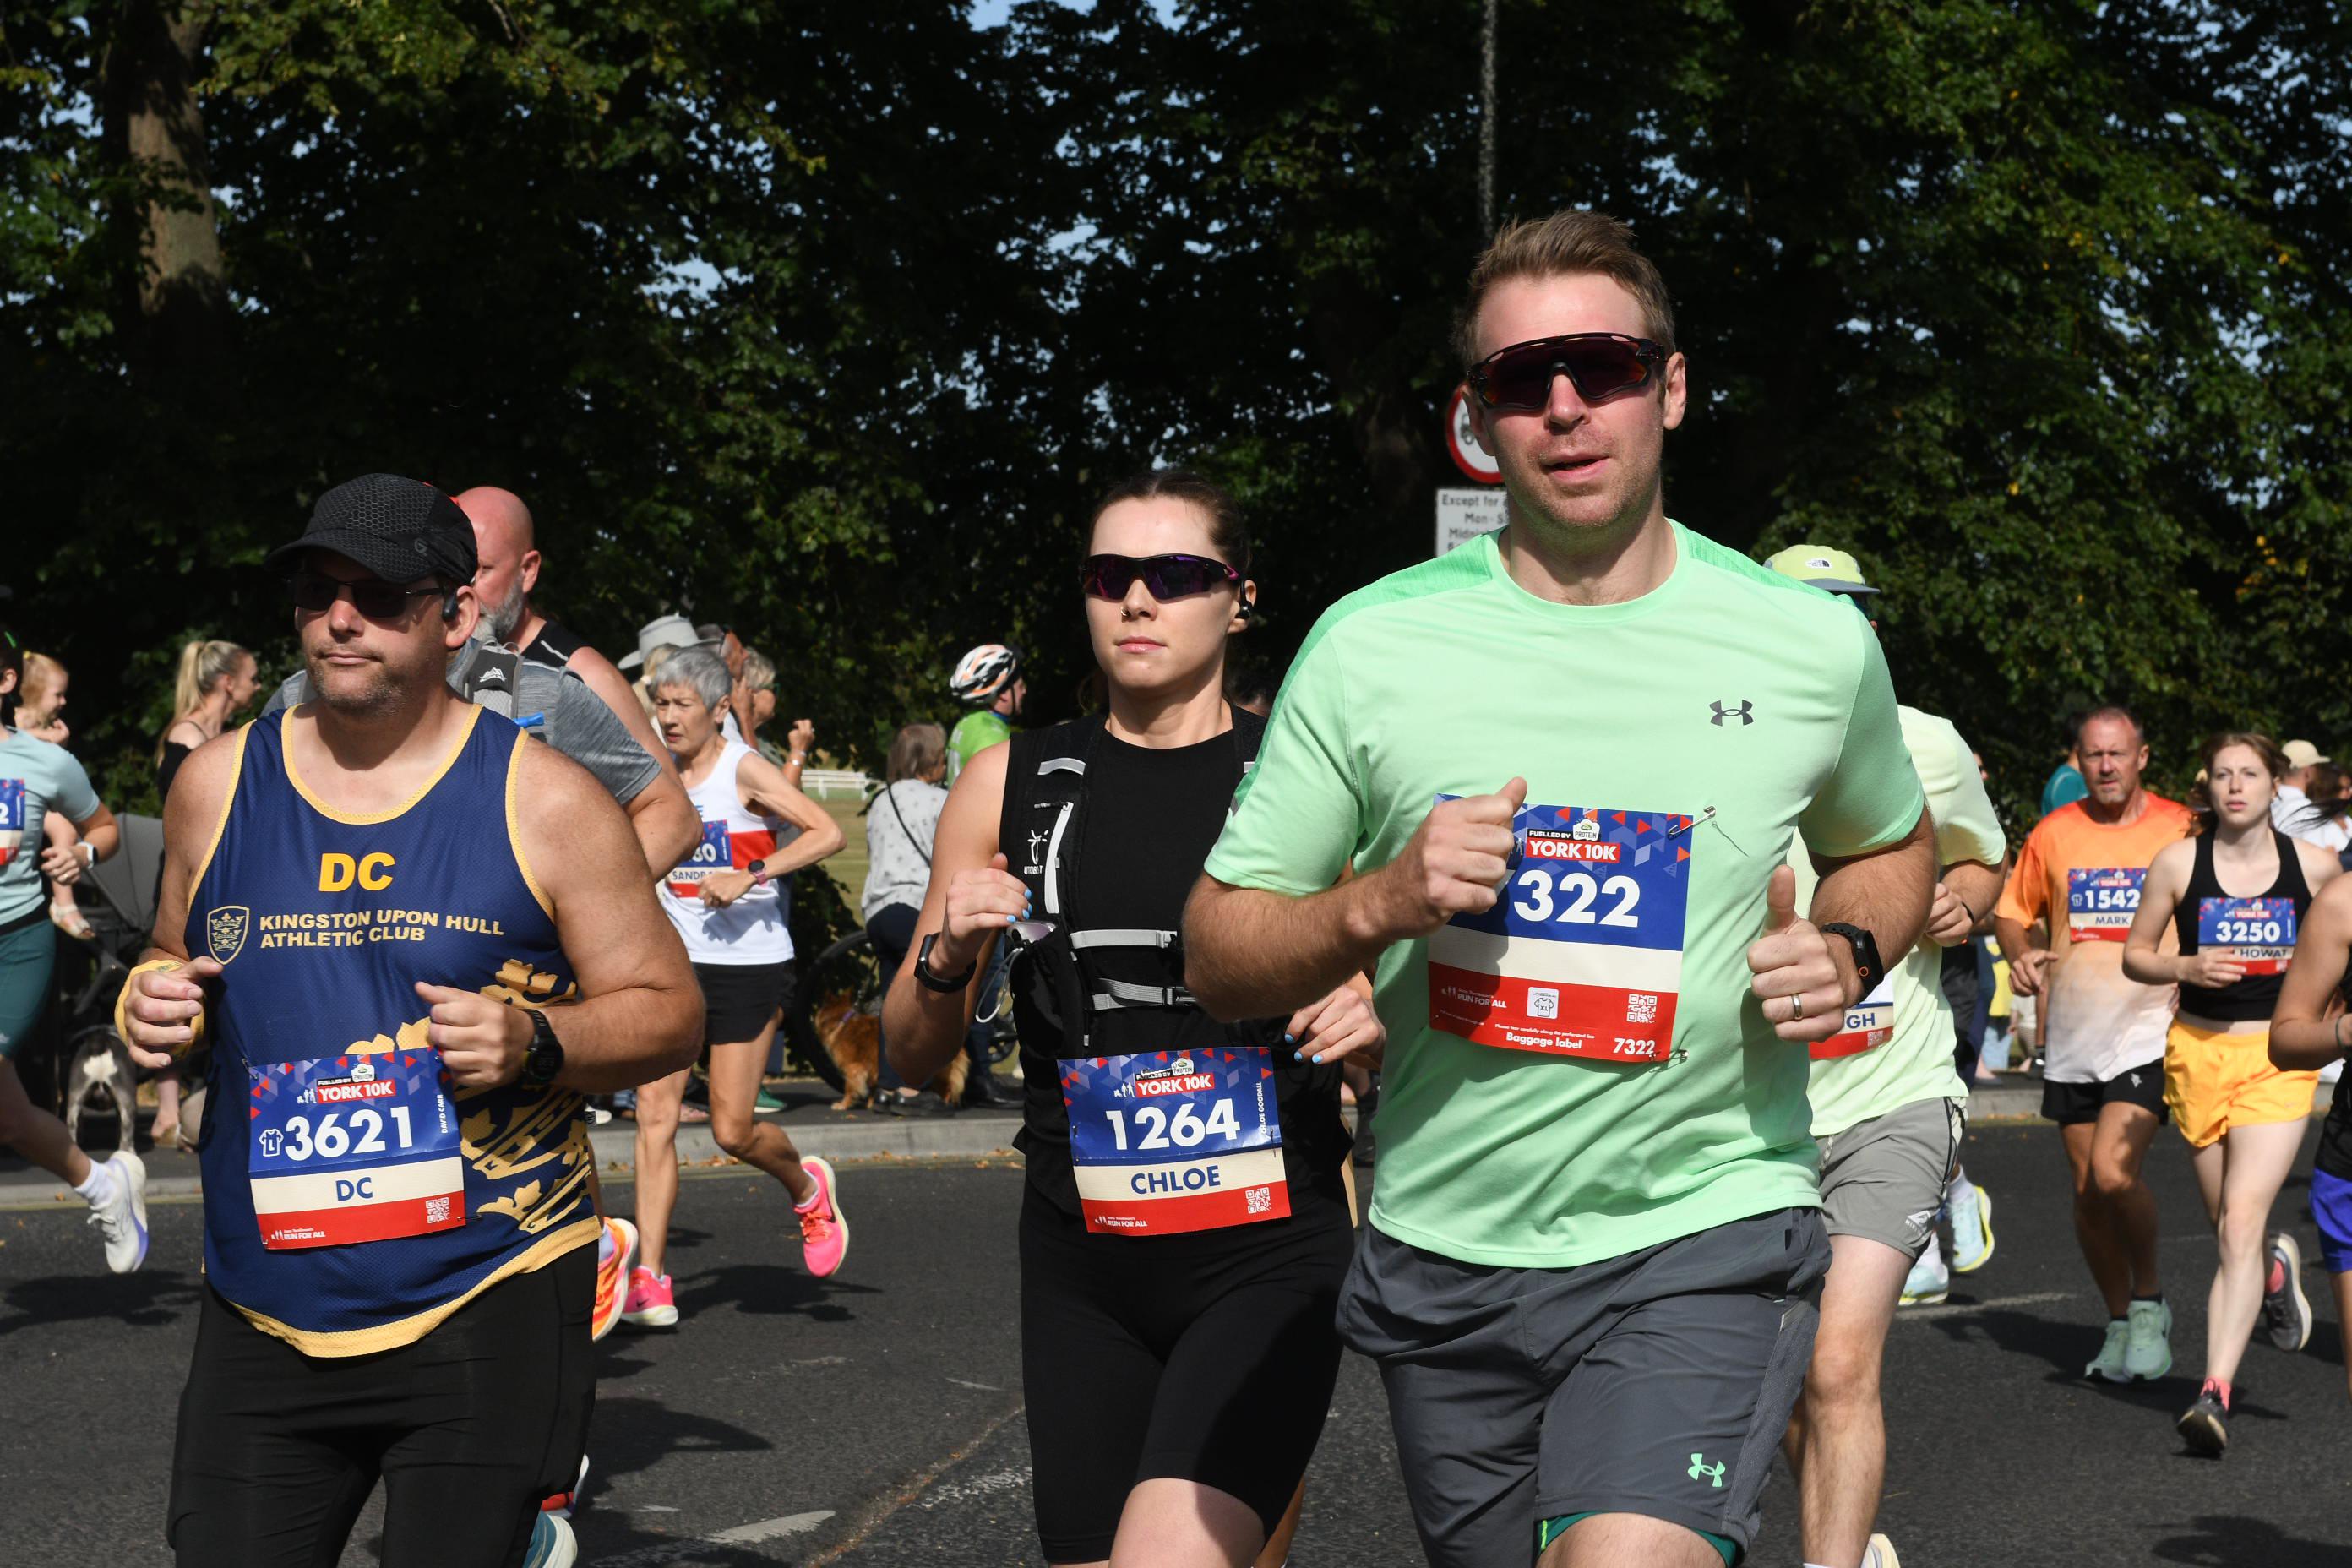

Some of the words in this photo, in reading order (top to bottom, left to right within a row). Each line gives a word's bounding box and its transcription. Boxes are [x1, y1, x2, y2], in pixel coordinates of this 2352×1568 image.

[1442, 494, 1478, 506] Except
[1484, 495, 1498, 506] for
[1465, 513, 1488, 523] Mon
[1529, 840, 1581, 858] YORK
[1585, 844, 1617, 860] 10K
[318, 852, 395, 892] DC
[672, 871, 712, 880] SANDR
[1514, 869, 1640, 928] 322
[2085, 889, 2141, 908] 1542
[259, 911, 371, 931] KINGSTON
[377, 909, 438, 927] UPON
[445, 915, 505, 936] HULL
[2216, 921, 2280, 942] 3250
[260, 929, 364, 948] ATHLETIC
[368, 927, 425, 942] CLUB
[2240, 949, 2287, 957] HOWAT
[1457, 994, 1473, 1002] RUN
[1846, 1012, 1876, 1029] GH
[1506, 1032, 1553, 1047] Baggage
[1555, 1037, 1582, 1048] label
[1613, 1038, 1655, 1055] 7322
[318, 1085, 363, 1102] YORK
[364, 1081, 394, 1097] 10K
[1138, 1078, 1183, 1096] YORK
[1184, 1075, 1212, 1091] 10K
[285, 1106, 412, 1161] 3621
[1106, 1098, 1240, 1151] 1264
[335, 1177, 373, 1201] DC
[1130, 1165, 1221, 1194] CHLOE
